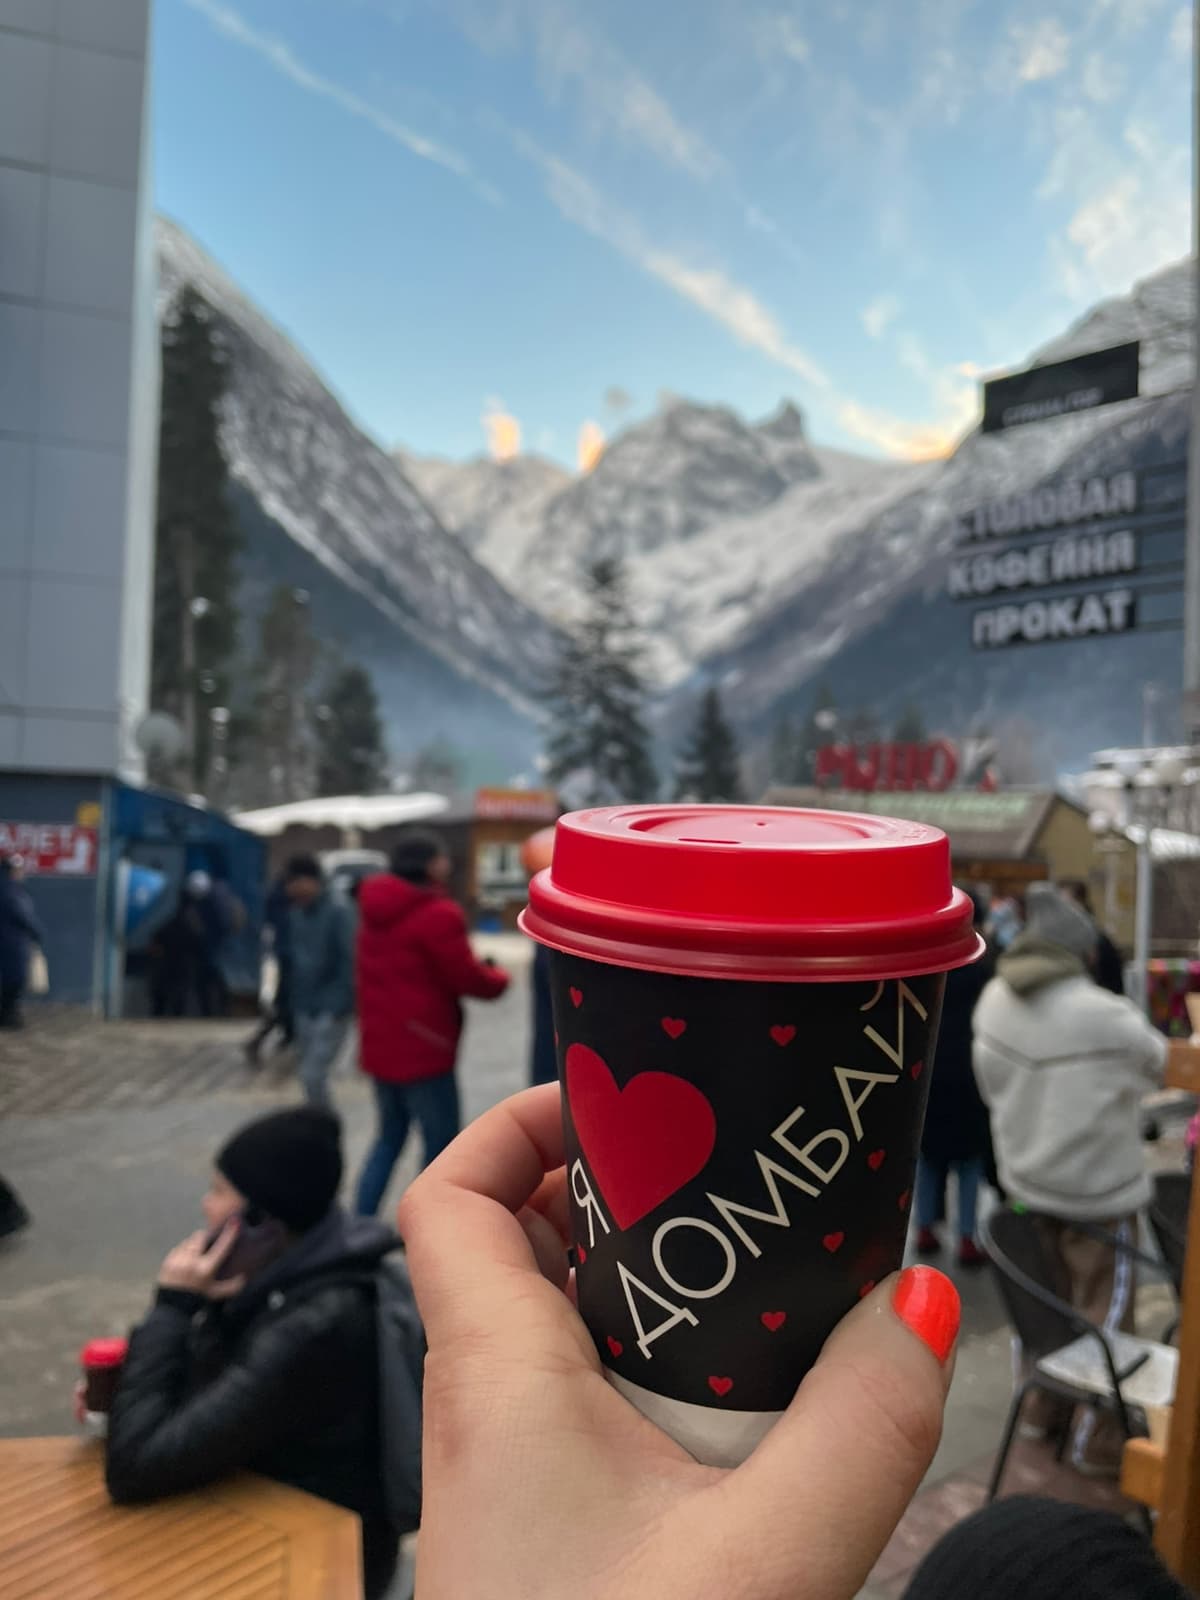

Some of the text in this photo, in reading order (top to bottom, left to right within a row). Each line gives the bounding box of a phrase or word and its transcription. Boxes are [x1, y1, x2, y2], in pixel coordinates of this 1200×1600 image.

[948, 529, 1135, 598] КОФЕЙНЯ
[972, 588, 1133, 647] ПРОКАТ
[571, 1157, 611, 1249] Я
[616, 979, 928, 1360] ДОМБАЙ
